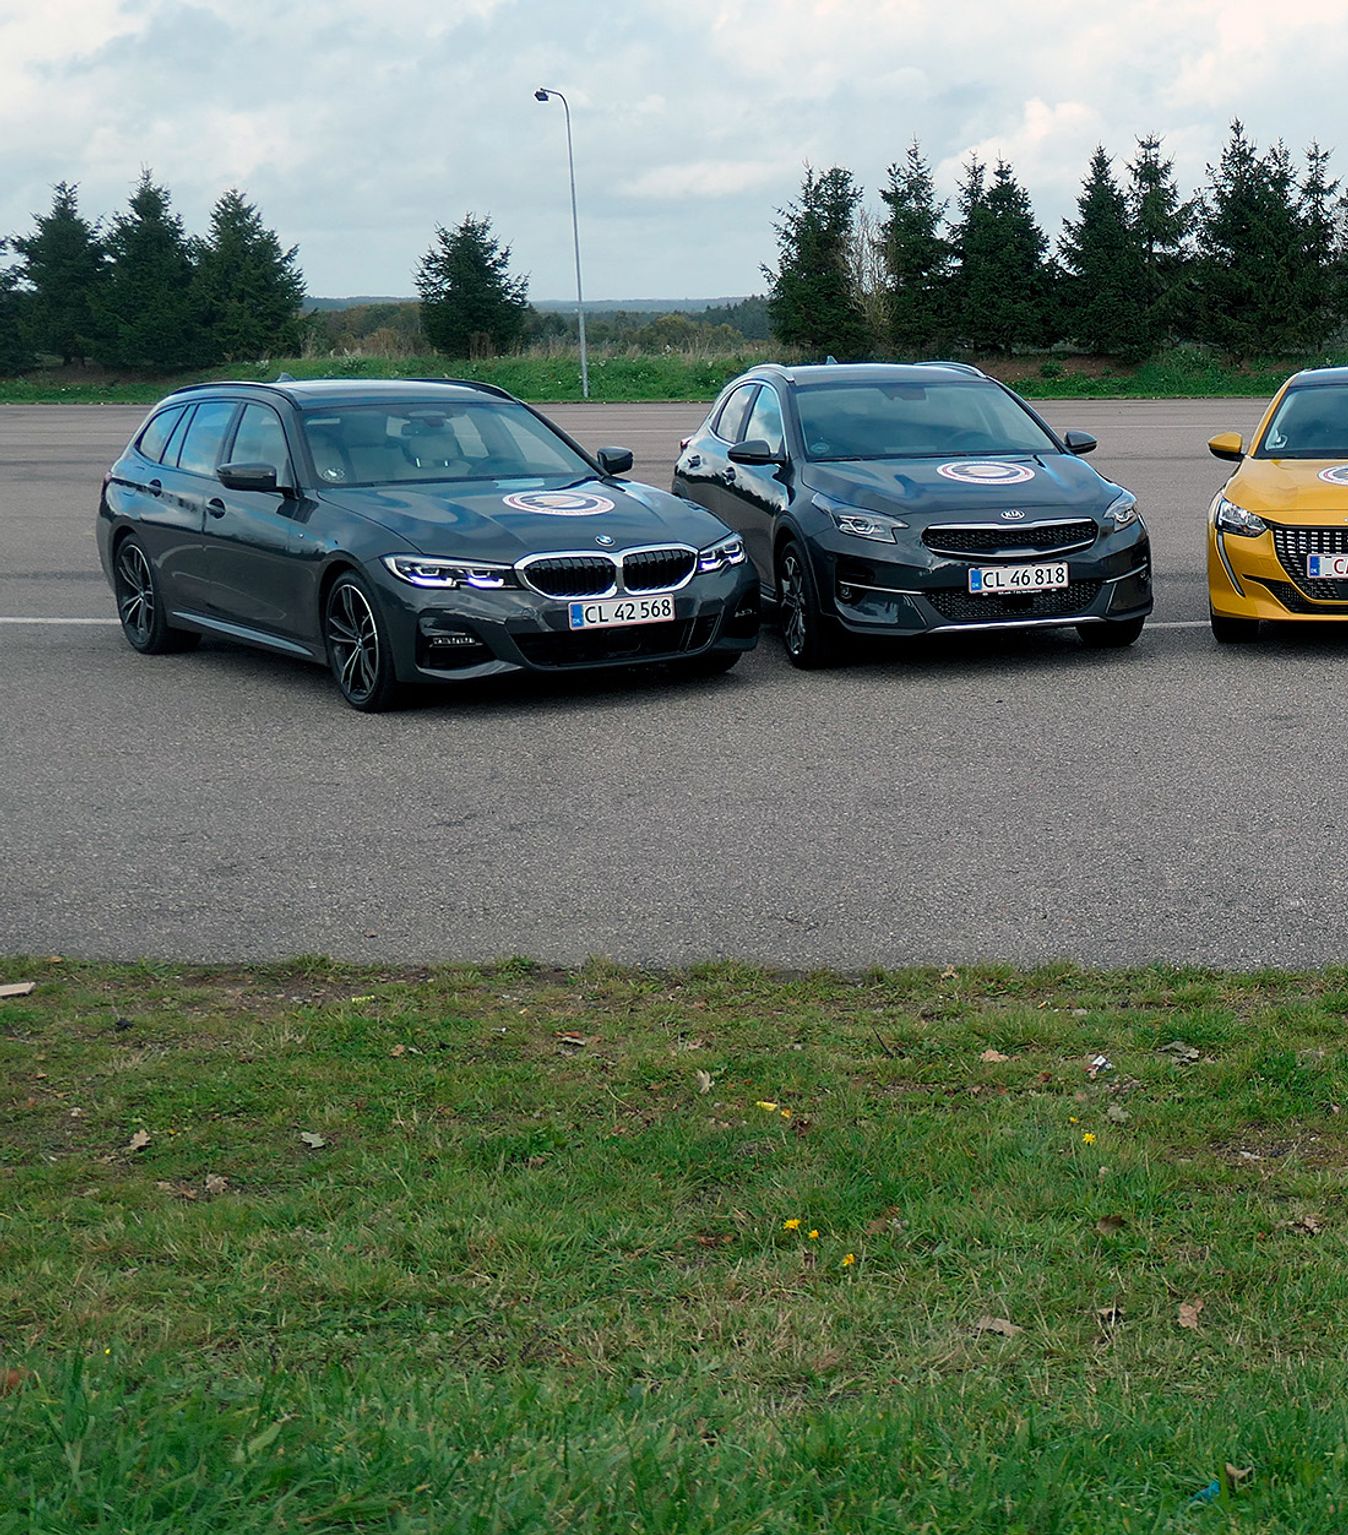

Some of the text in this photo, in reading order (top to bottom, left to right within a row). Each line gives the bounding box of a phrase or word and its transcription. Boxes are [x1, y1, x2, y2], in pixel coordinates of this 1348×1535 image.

[983, 567, 1065, 588] CL 46 818
[585, 599, 671, 624] CL 42 568
